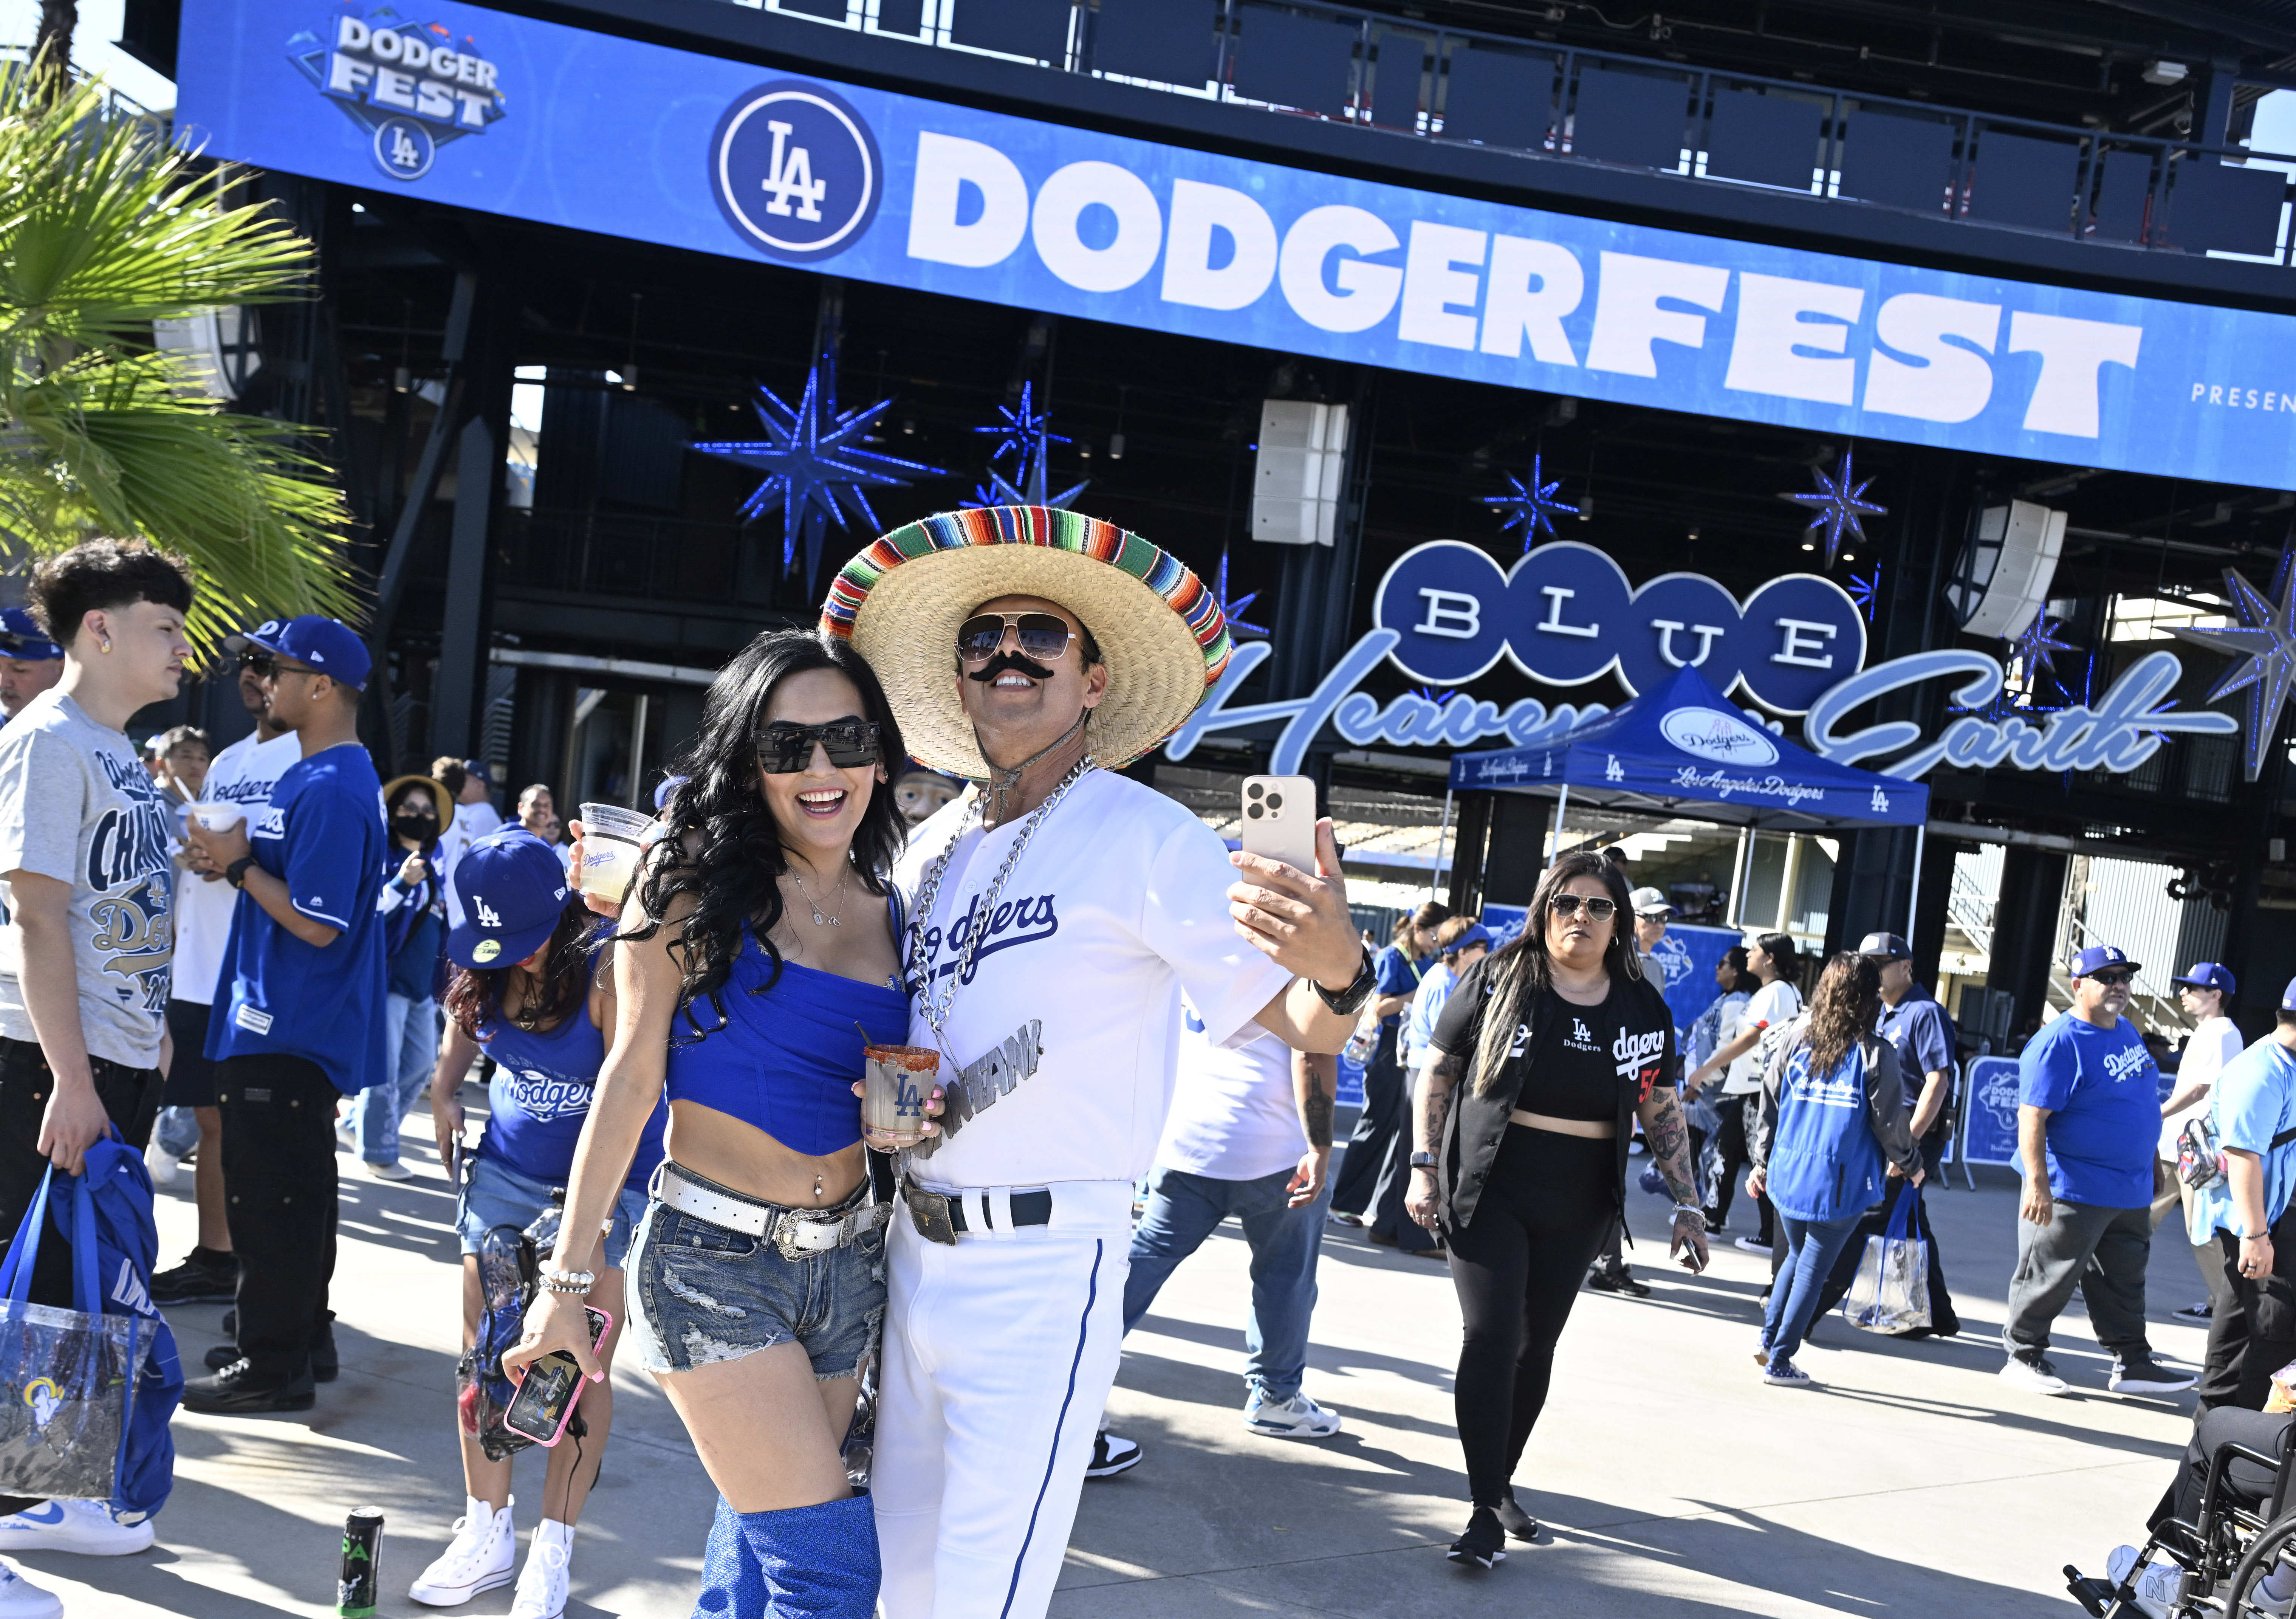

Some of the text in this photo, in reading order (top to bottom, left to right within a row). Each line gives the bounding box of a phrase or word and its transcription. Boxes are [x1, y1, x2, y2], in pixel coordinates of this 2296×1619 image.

[336, 15, 499, 91] DODGER
[328, 51, 492, 127] FEST
[390, 126, 419, 168] LA
[762, 120, 826, 222] LA
[907, 130, 2296, 438] DODGERFEST PRESEN
[1413, 587, 1838, 670] BLUE
[1681, 732, 1757, 751] Dodgers
[1605, 754, 1625, 782] LA
[1671, 765, 1825, 807] Los Angeles Dodgers
[1870, 785, 1889, 813] LA
[583, 851, 615, 867] Dodgers
[473, 895, 502, 927] LA
[2102, 945, 2120, 960] LA
[1564, 1039, 1601, 1052] Dodgers
[1573, 1018, 1591, 1042] LA
[507, 1074, 597, 1122] odger
[894, 1074, 923, 1116] LA
